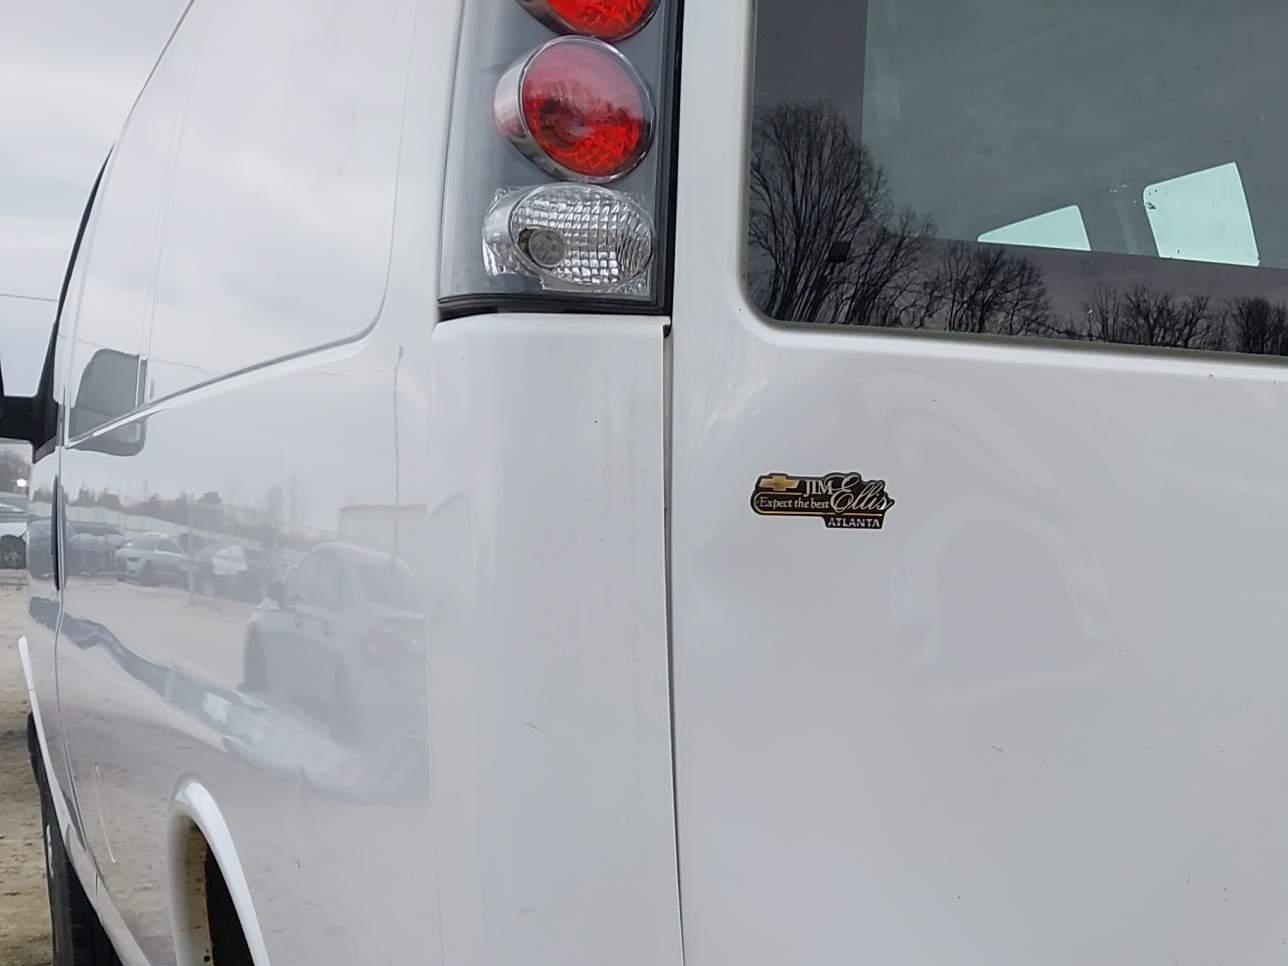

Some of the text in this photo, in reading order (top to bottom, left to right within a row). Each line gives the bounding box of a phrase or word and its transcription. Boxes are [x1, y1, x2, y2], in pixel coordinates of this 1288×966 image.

[803, 474, 895, 513] JIM Ellis
[759, 497, 830, 510] Expect the best
[827, 517, 881, 528] ATLANTA
